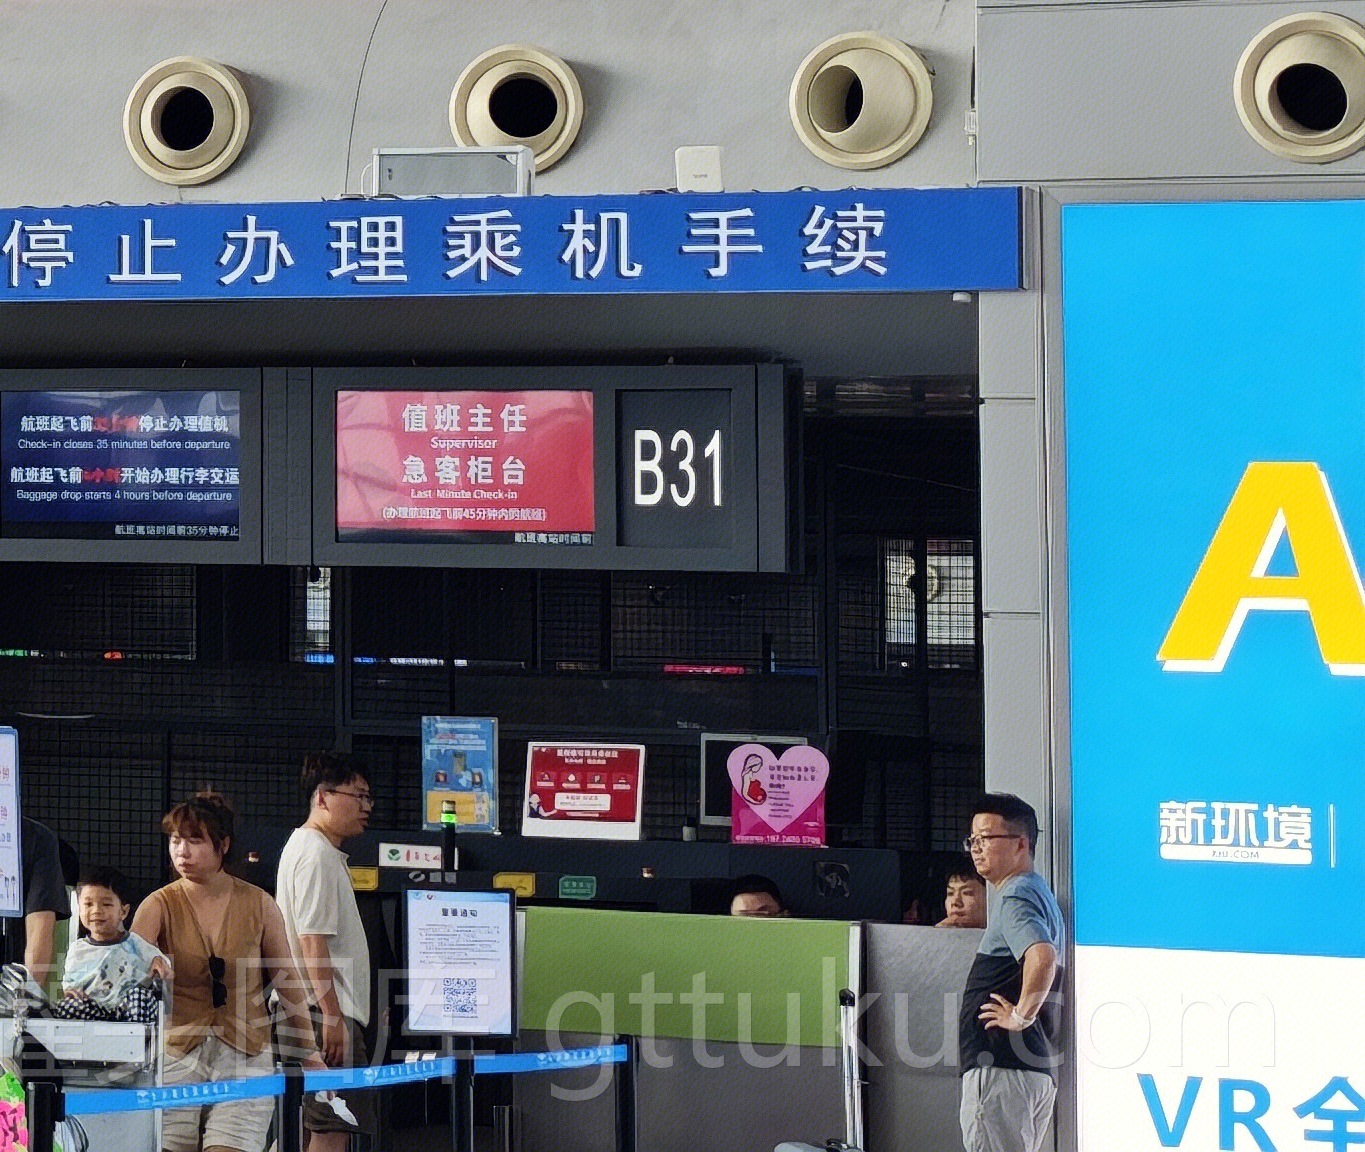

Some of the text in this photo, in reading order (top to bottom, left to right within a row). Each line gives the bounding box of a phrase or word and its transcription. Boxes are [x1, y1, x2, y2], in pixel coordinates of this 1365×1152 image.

[401, 404, 528, 434] 值班主任
[430, 436, 498, 451] Supervisor
[401, 456, 527, 485] 急客柜台
[634, 429, 723, 507] B31
[1159, 800, 1313, 849] 新环境
